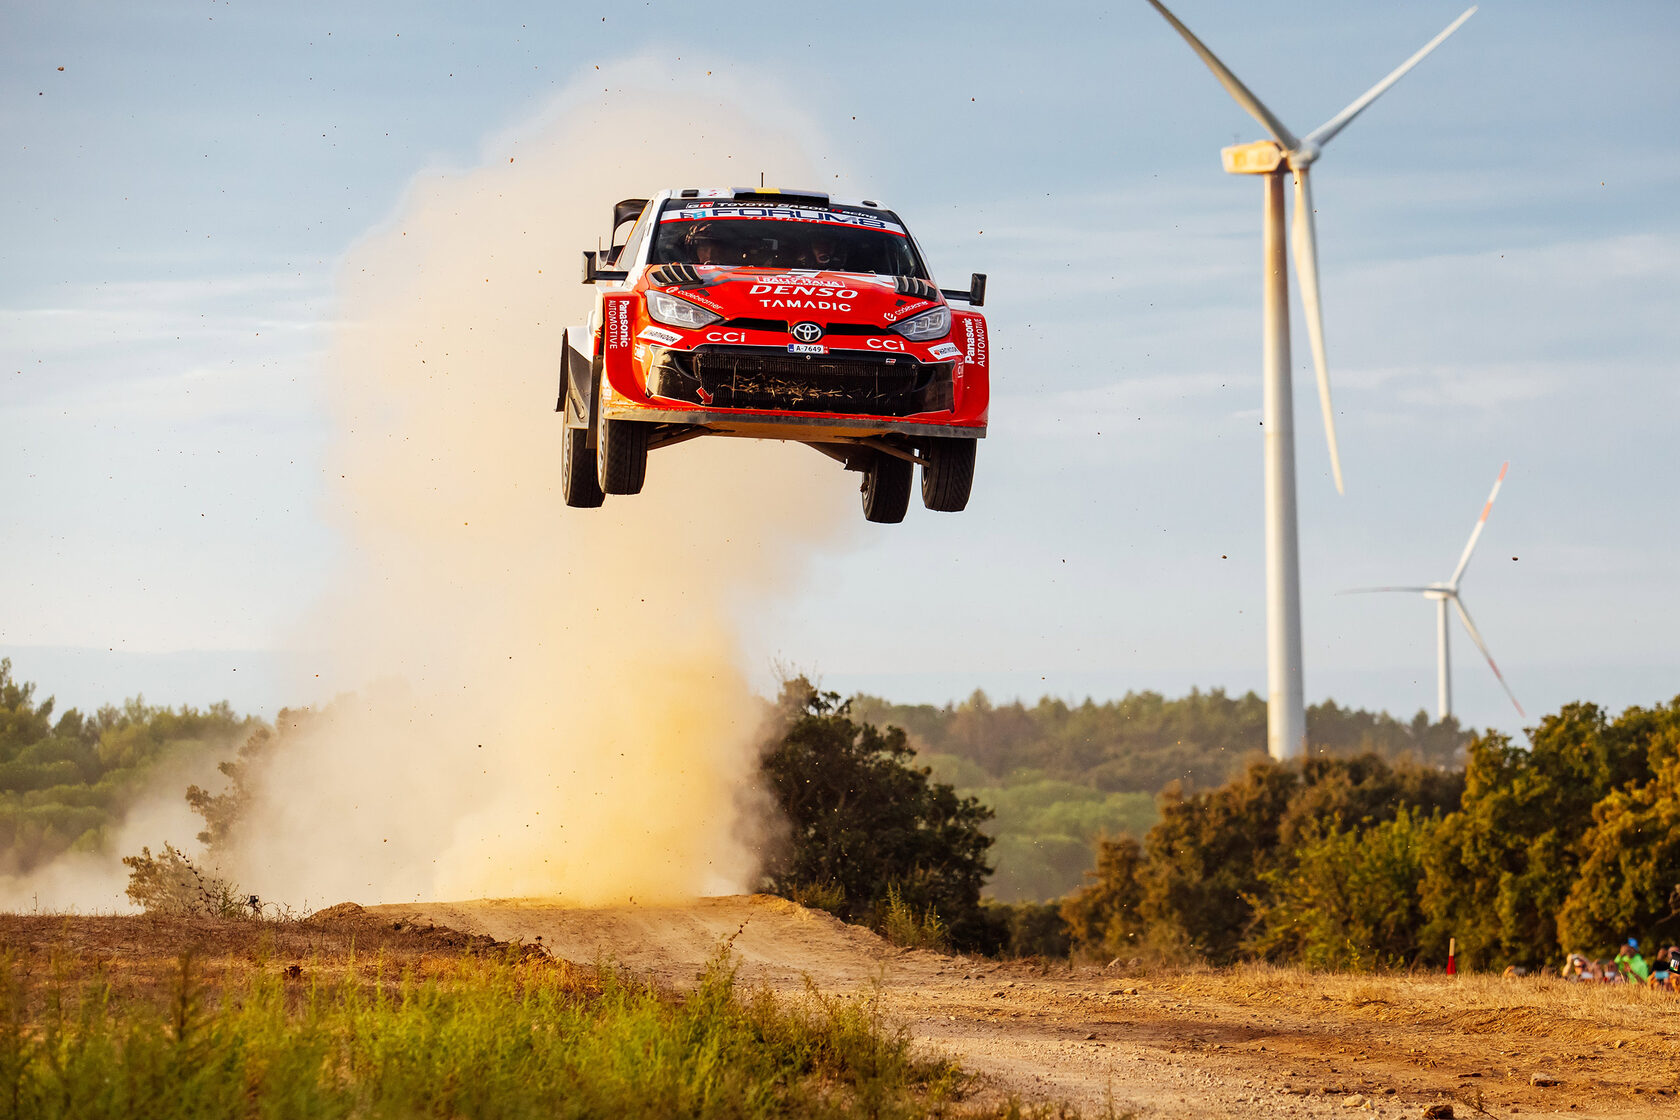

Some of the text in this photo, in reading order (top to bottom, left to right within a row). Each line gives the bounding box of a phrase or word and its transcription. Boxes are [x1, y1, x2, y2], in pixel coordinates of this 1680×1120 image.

[712, 209, 886, 229] FORUM8
[777, 203, 829, 212] GAZOO
[831, 208, 878, 220] Racing
[749, 284, 859, 299] DENSO
[759, 299, 852, 312] TAMADIC
[608, 299, 618, 350] AUTOMOTIVE
[619, 300, 631, 348] Panasonic
[706, 332, 745, 342] CCi
[866, 338, 905, 351] CCi
[962, 318, 975, 365] Panasonic
[974, 318, 986, 368] AUTOMOTIVE
[795, 345, 822, 353] A-7649
